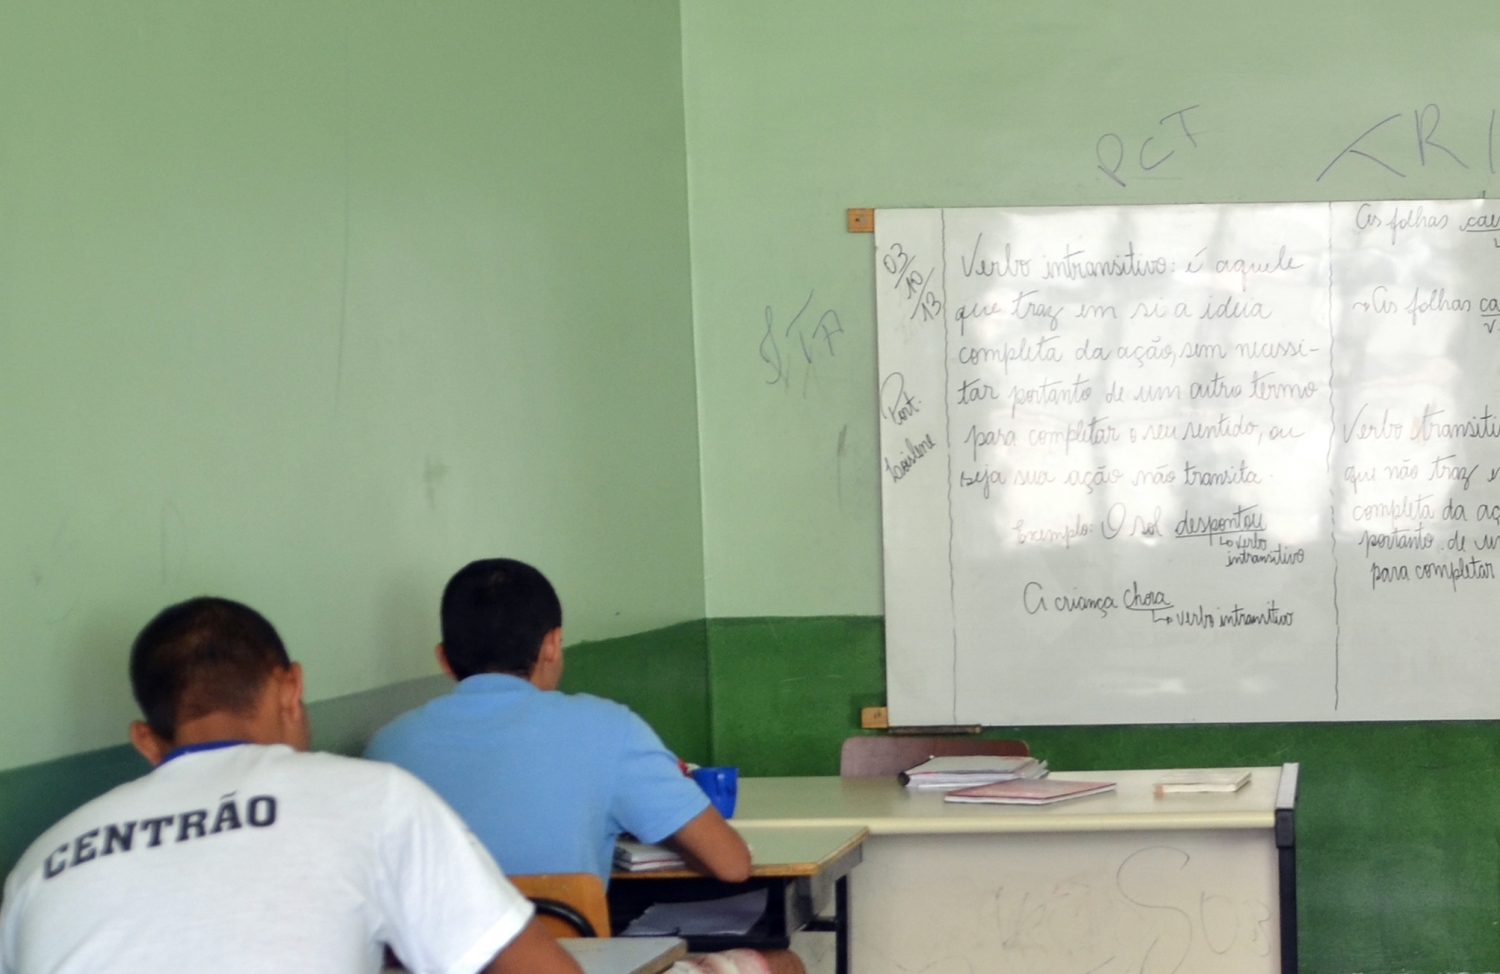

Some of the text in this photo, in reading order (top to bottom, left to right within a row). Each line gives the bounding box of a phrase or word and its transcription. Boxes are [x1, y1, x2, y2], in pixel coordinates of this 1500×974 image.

[1386, 205, 1449, 246] folhas
[960, 231, 1032, 279] Verbo
[1186, 246, 1208, 275] é
[1214, 245, 1305, 292] aquele
[955, 302, 1001, 336] que
[1012, 289, 1064, 330] traz
[1075, 303, 1117, 320] em
[1130, 301, 1167, 320] si
[1173, 303, 1194, 319] a
[1405, 286, 1471, 326] folhas
[958, 336, 1064, 376] completa
[1075, 337, 1112, 361] da
[1178, 341, 1227, 359] sem
[957, 371, 1319, 419] tar portanto de um outro termo
[964, 424, 1018, 462] para
[1029, 416, 1120, 451] completar
[1142, 426, 1178, 443] seu
[1268, 426, 1306, 441] ou
[1343, 403, 1403, 444] Verbo
[959, 466, 1007, 500] seja
[1014, 469, 1057, 487] sua
[1063, 465, 1122, 496] ação
[1131, 464, 1177, 487] não
[1344, 465, 1376, 495] que
[1383, 459, 1419, 482] não
[1428, 454, 1480, 490] traz
[1100, 502, 1128, 540] O
[1129, 516, 1163, 539] sol
[1174, 504, 1268, 547] despontou
[1351, 493, 1435, 526] completa
[1442, 497, 1469, 523] da
[1225, 538, 1306, 567] intransitivo
[1233, 531, 1269, 551] verbo
[1359, 522, 1435, 559] portanto
[1369, 561, 1410, 591] para
[1414, 556, 1496, 593] completar
[1054, 586, 1120, 618] criança
[1123, 580, 1174, 610] chora
[1175, 600, 1295, 630] verbo intransitivo
[43, 791, 279, 880] CENTRÃO
